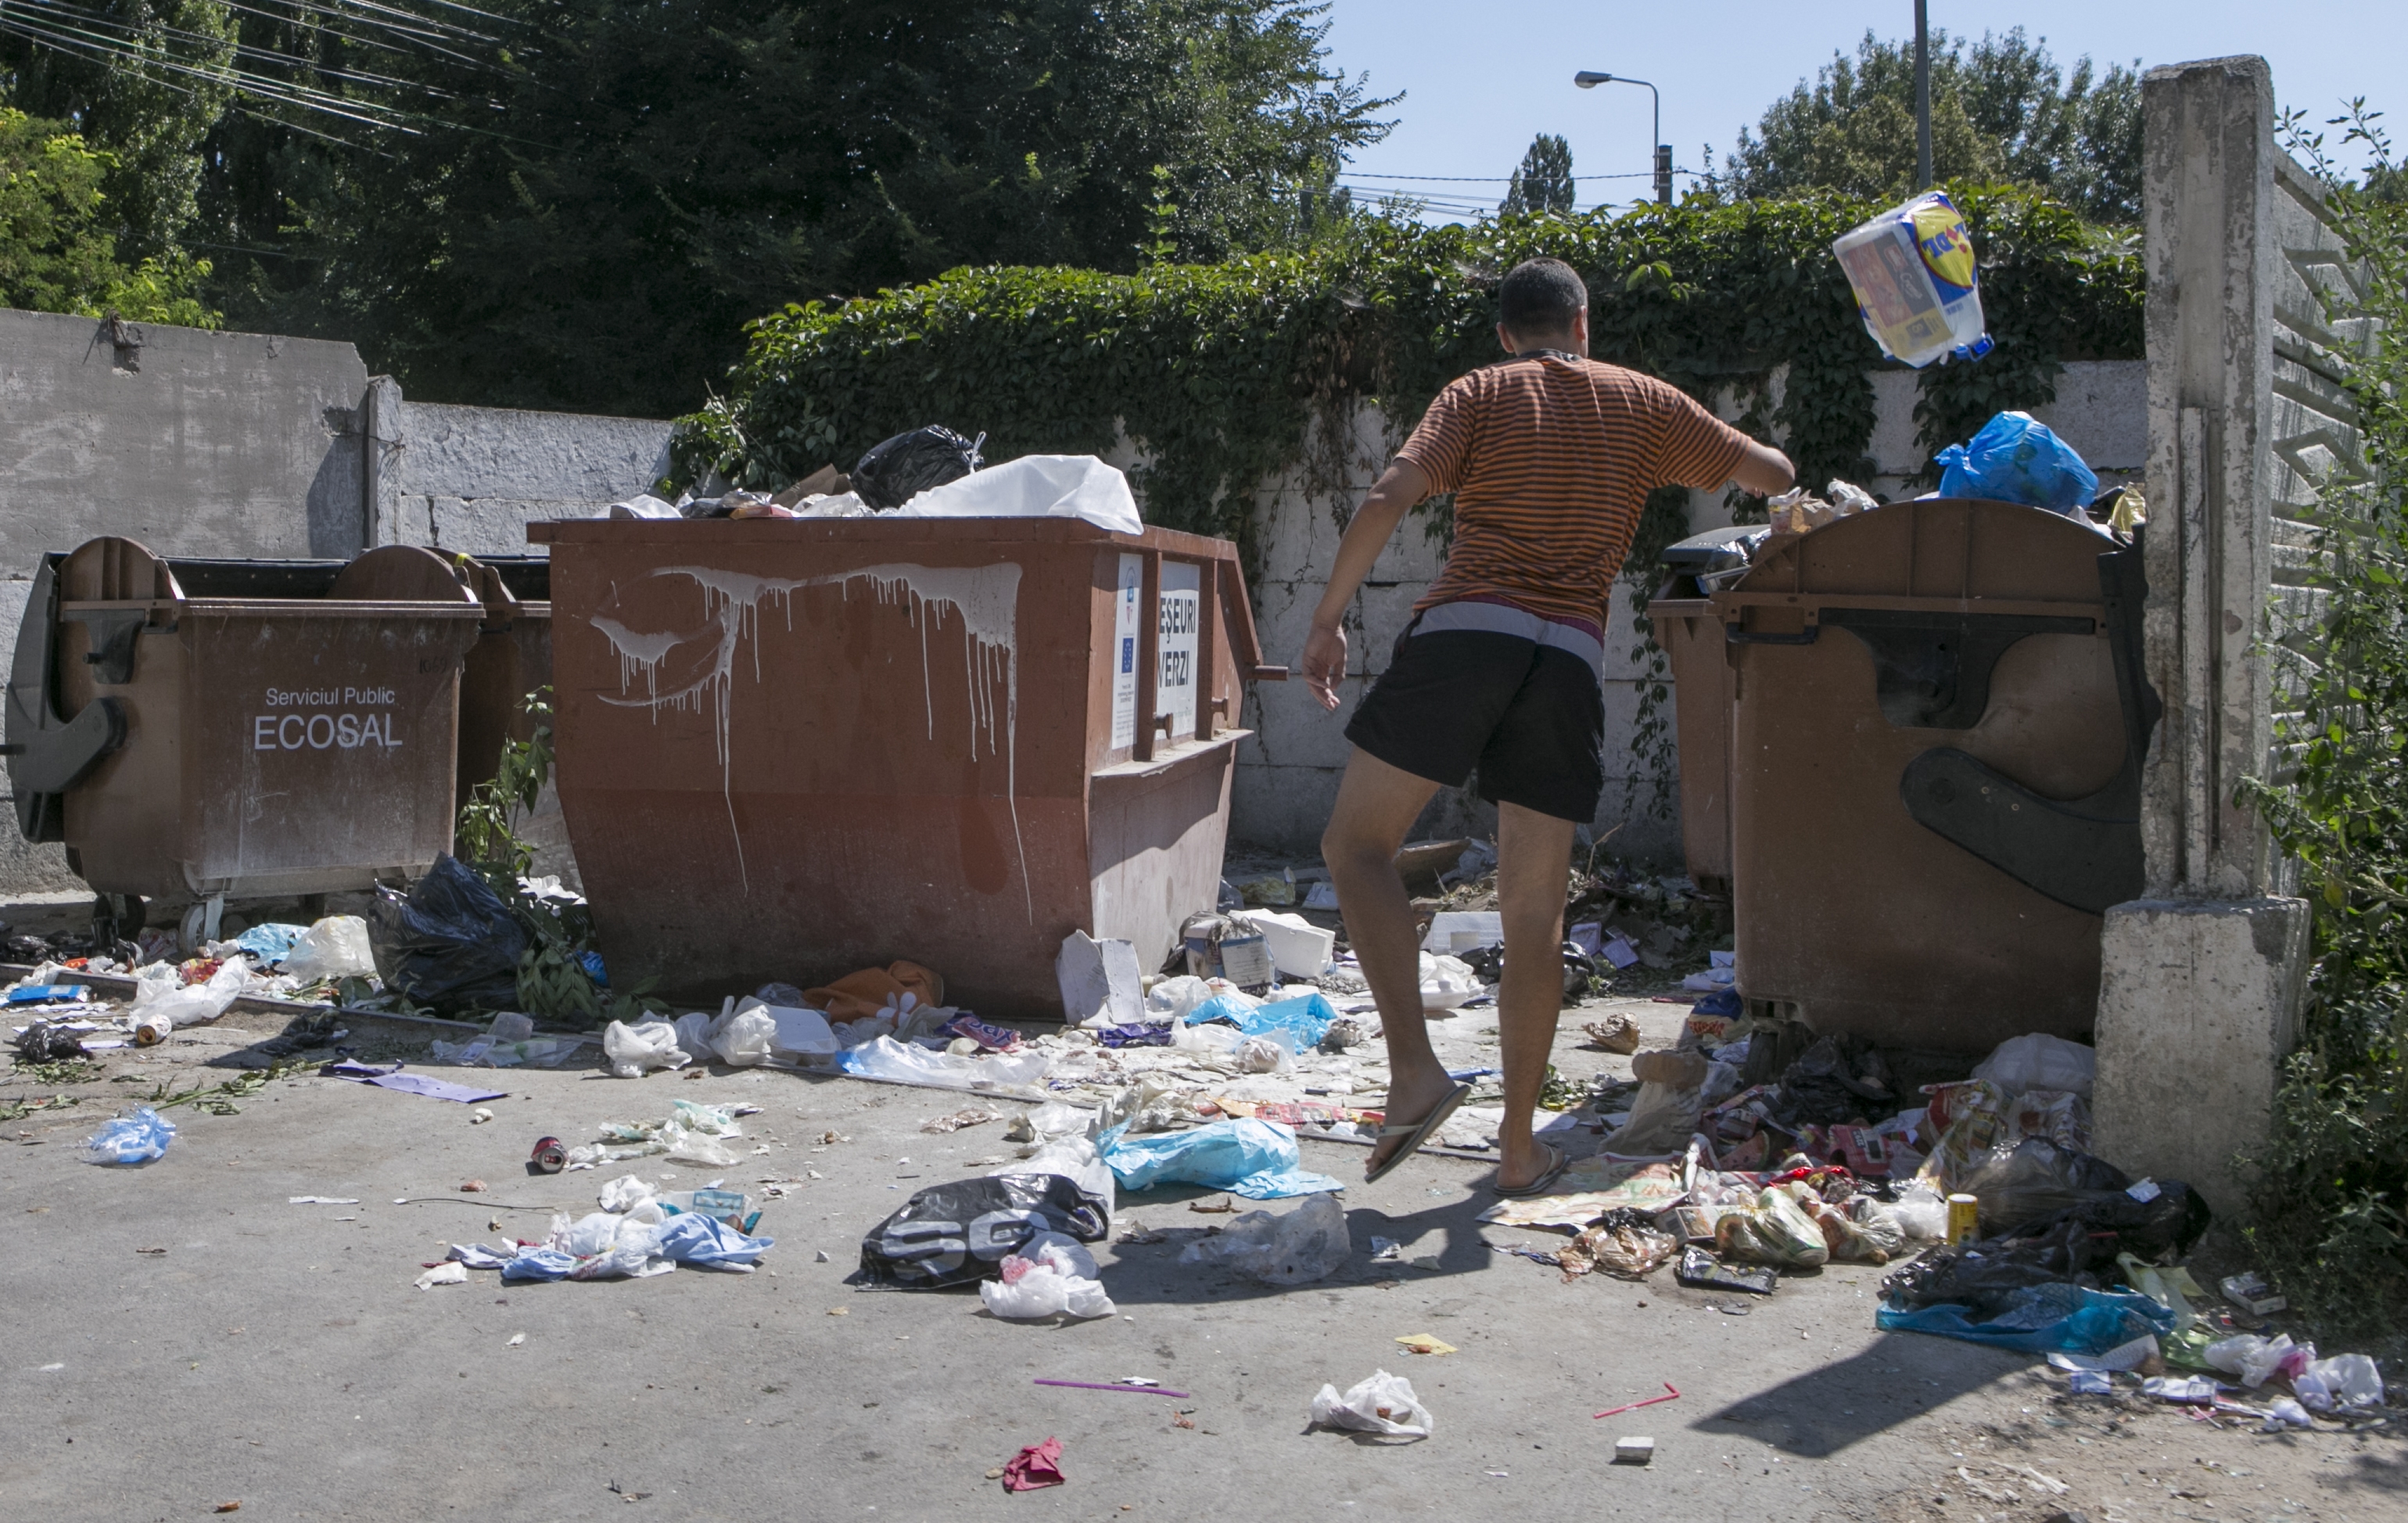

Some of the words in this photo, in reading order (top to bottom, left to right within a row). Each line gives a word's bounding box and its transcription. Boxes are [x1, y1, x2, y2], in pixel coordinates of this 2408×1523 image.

[1157, 650, 1190, 688] VERZI
[266, 688, 339, 706] Serviciul
[344, 687, 395, 704] Public
[254, 713, 403, 749] ECOSAL
